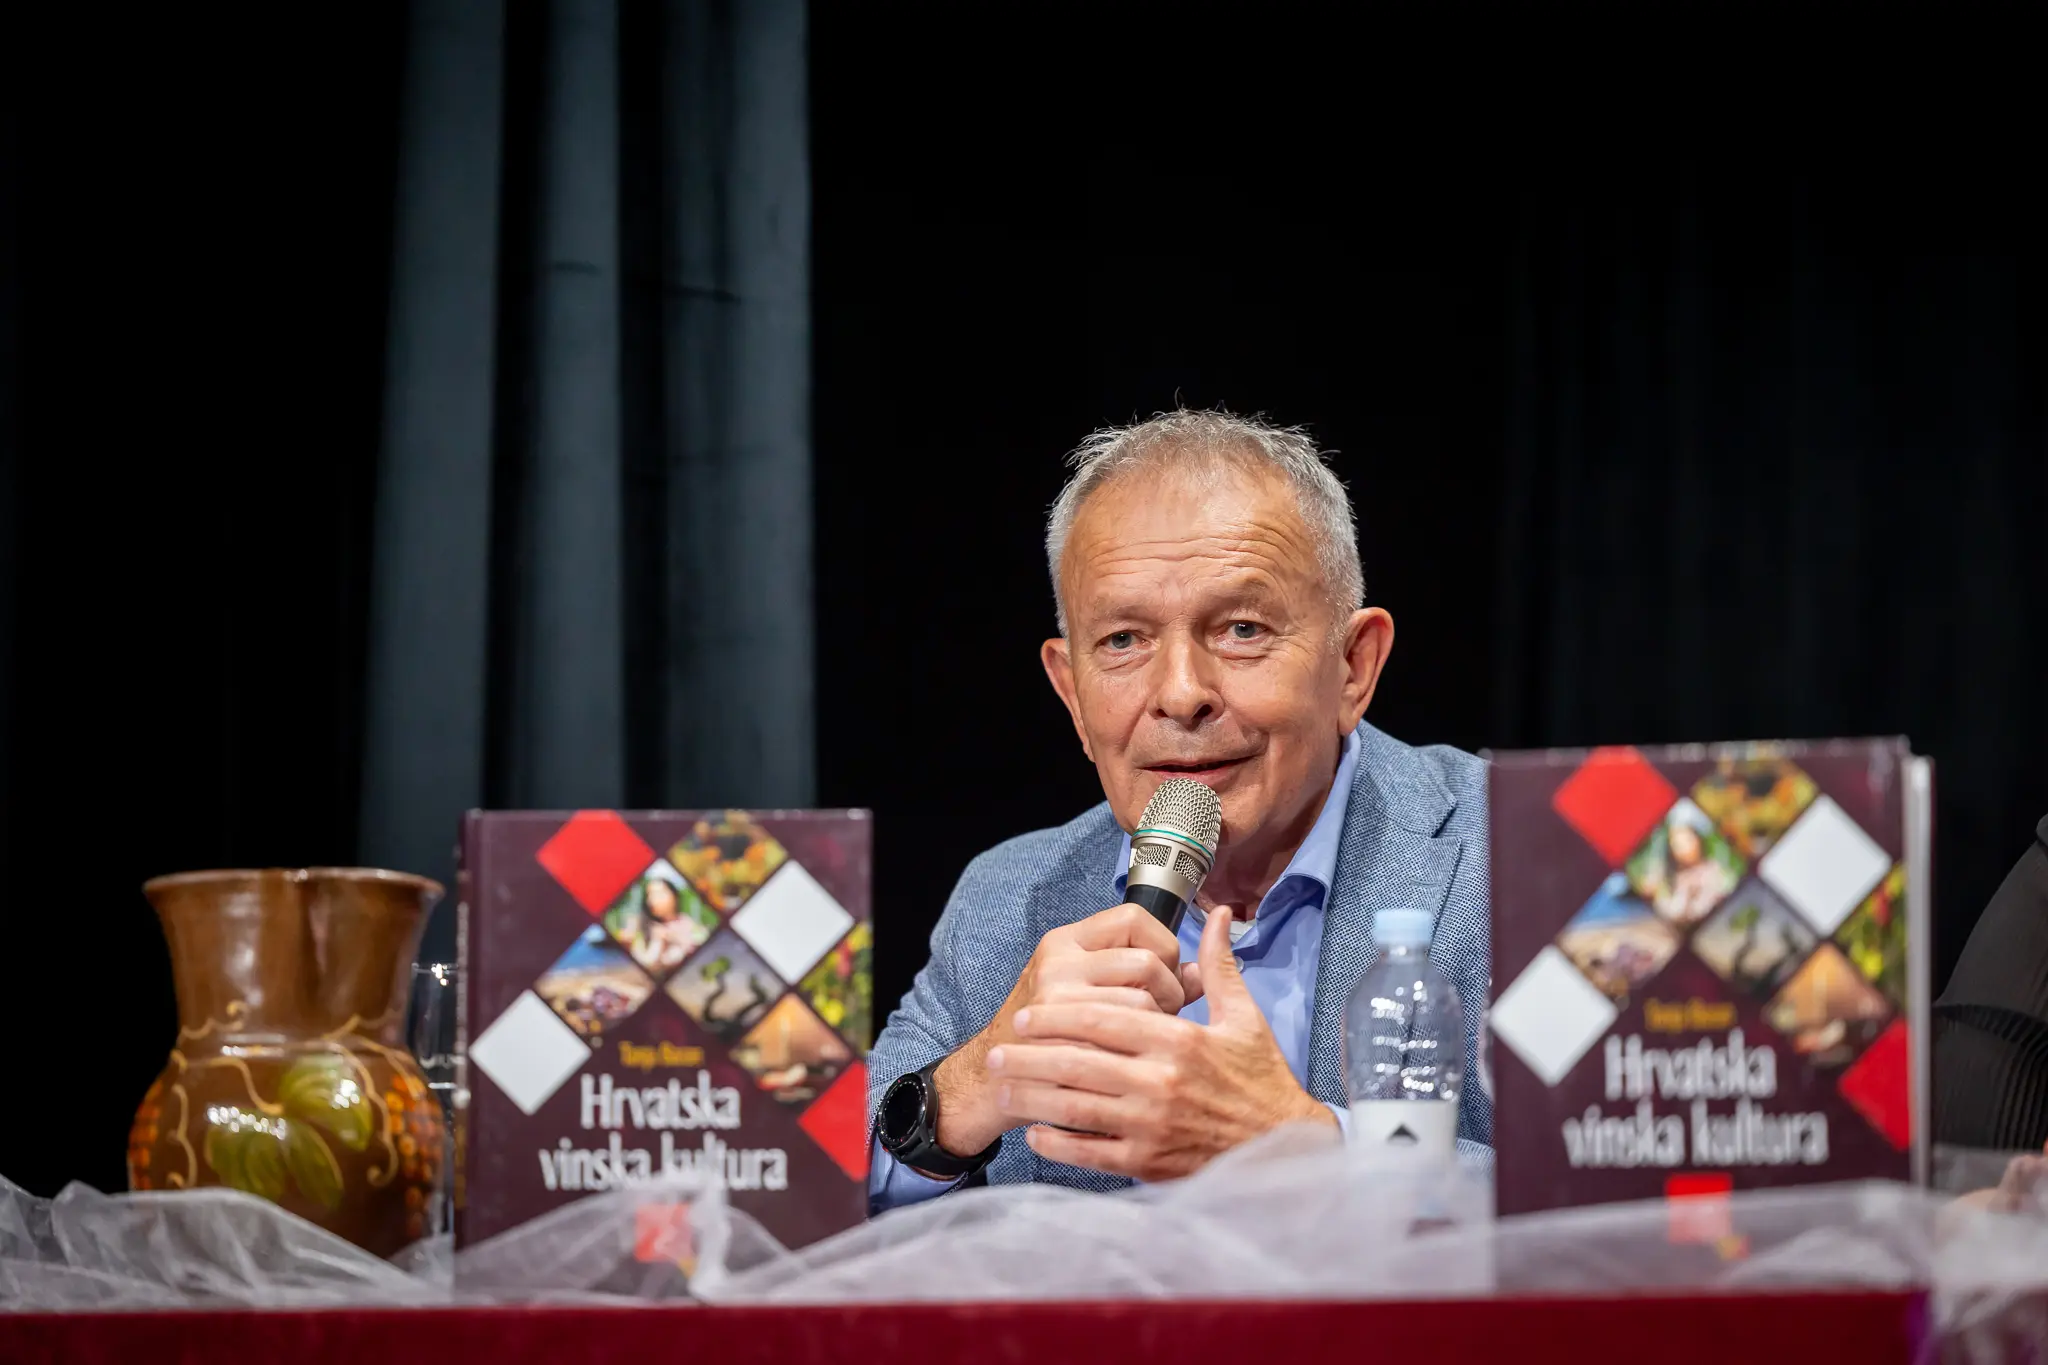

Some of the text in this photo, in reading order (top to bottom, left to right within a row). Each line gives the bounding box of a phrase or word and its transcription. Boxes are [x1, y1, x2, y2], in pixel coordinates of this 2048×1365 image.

[1605, 1029, 1777, 1099] Hrvatska
[581, 1070, 740, 1129] Hrvatska
[539, 1132, 651, 1189] vinska
[1563, 1098, 1828, 1167] vinska kultura
